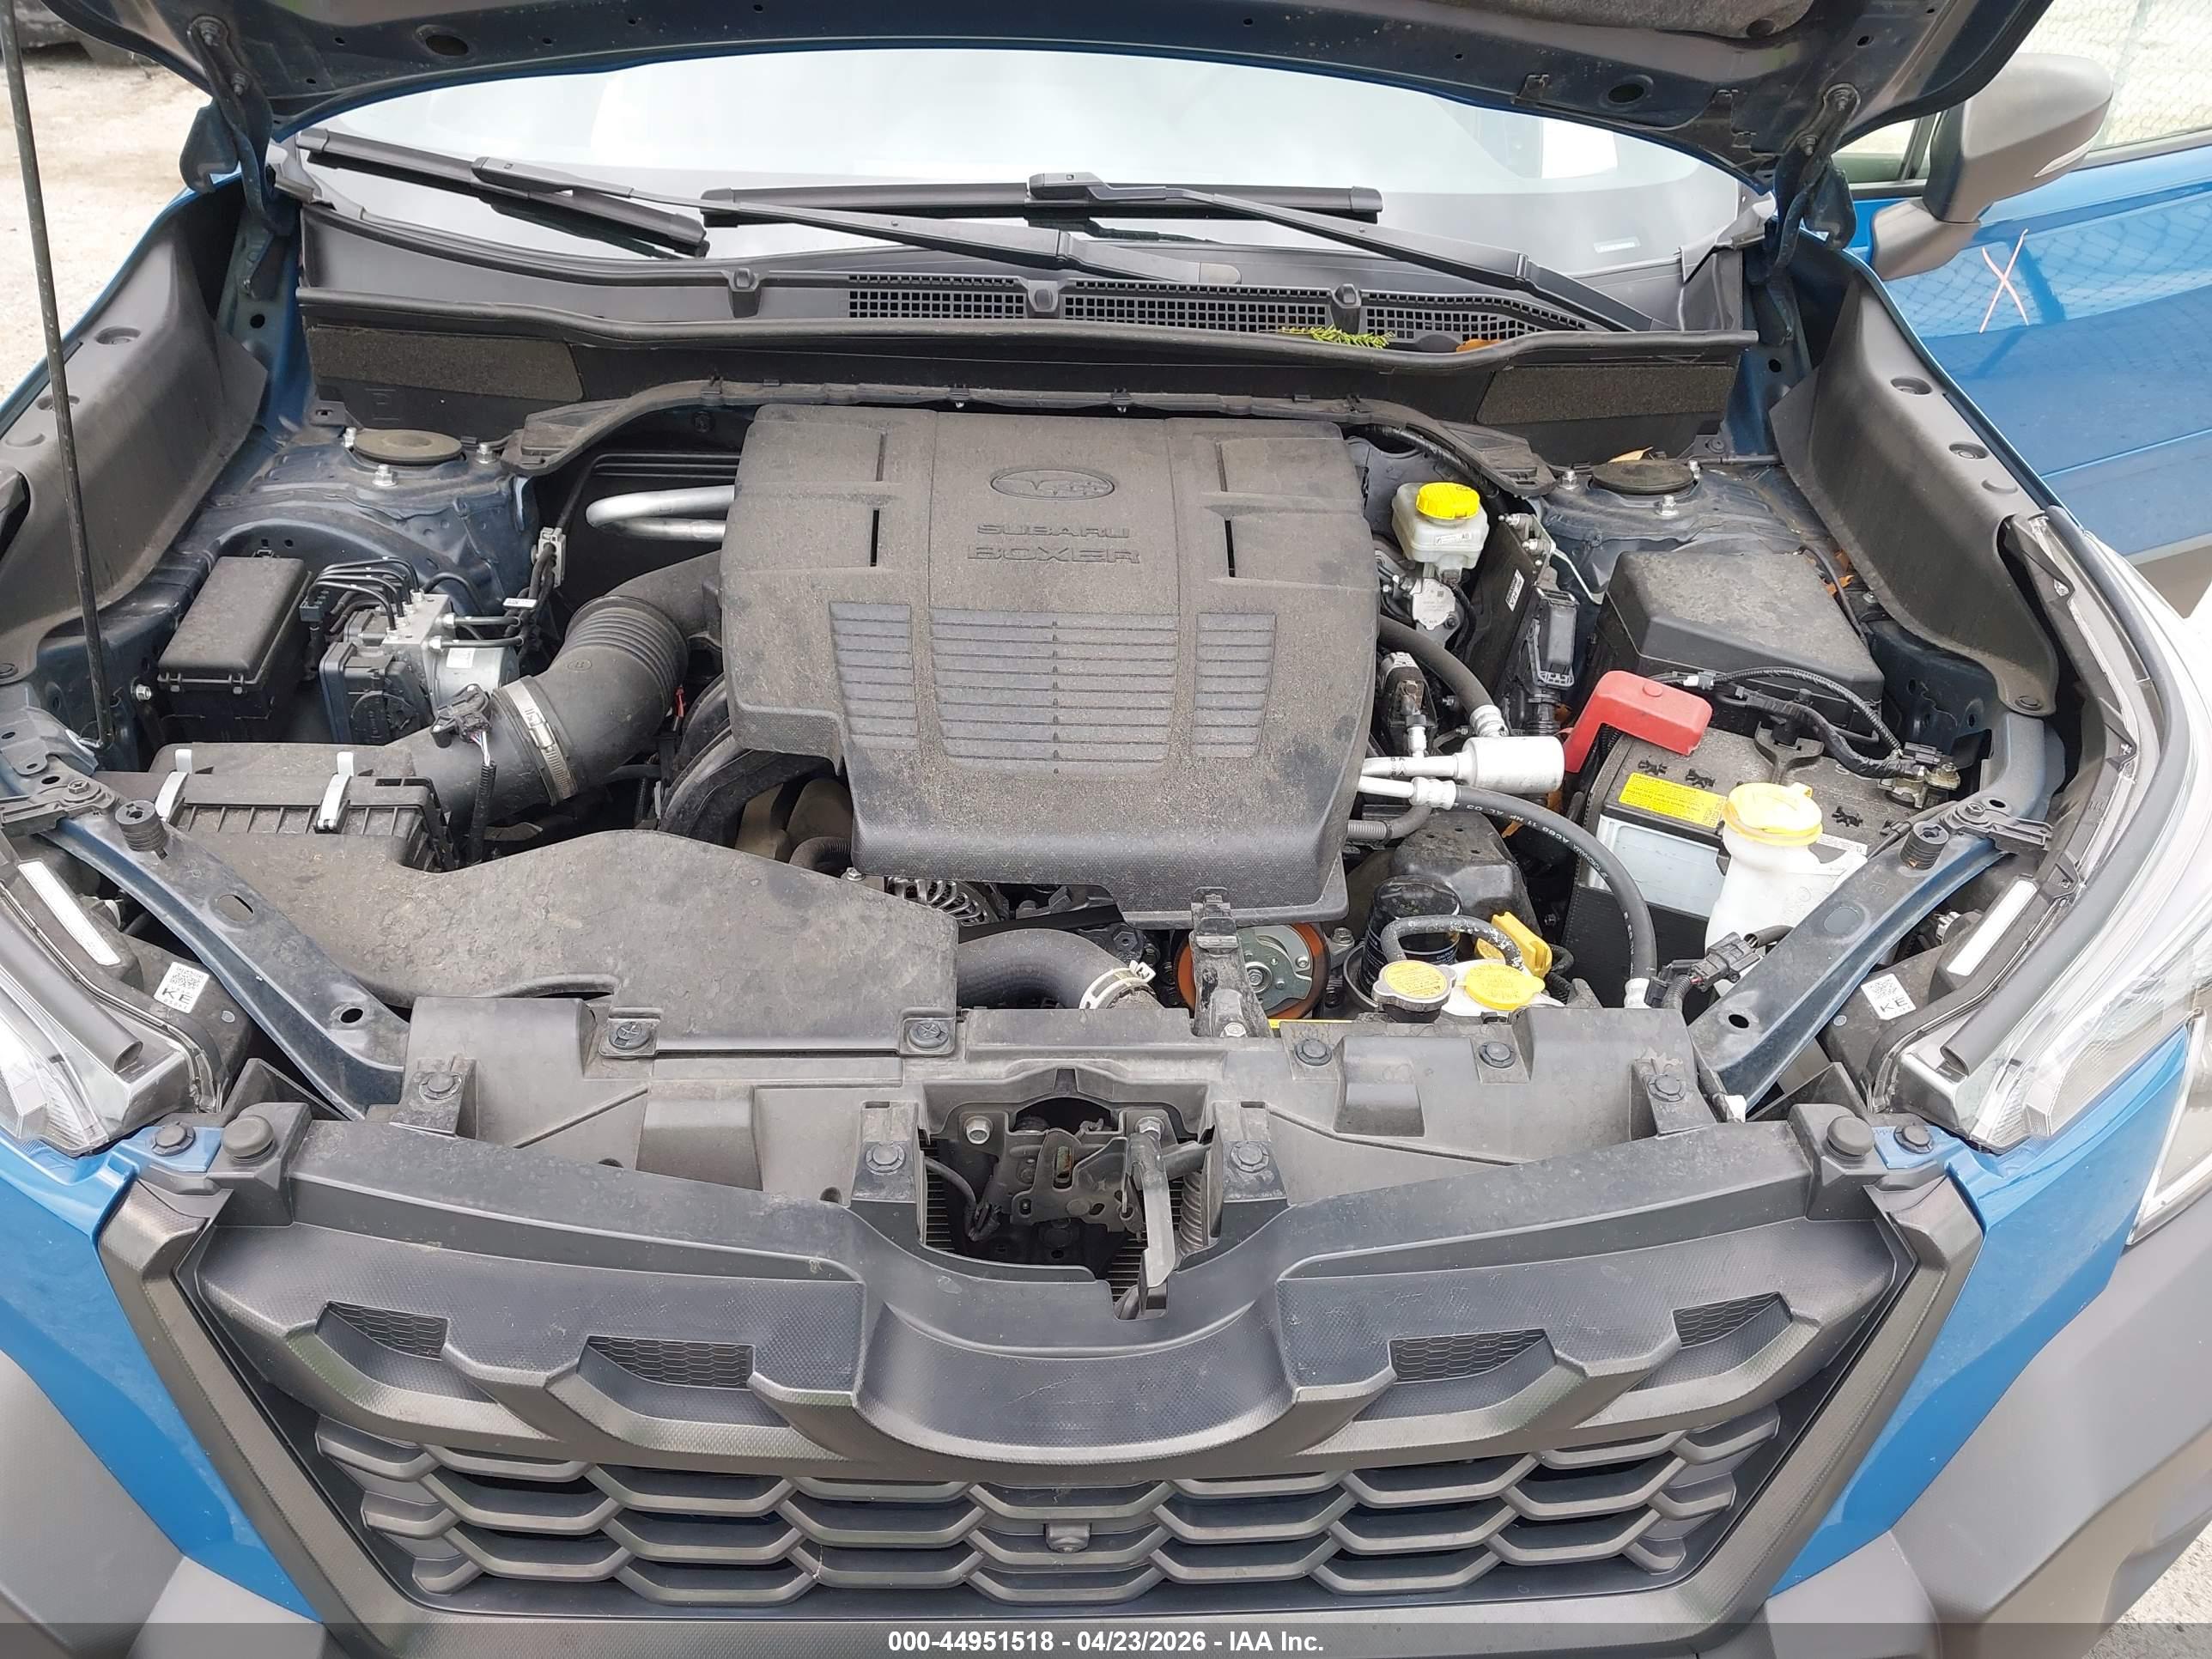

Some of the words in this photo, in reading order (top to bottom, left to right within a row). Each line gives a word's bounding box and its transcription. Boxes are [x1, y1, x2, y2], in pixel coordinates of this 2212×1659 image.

[977, 524, 1130, 538] SUBARU
[968, 545, 1139, 563] BOXER
[1572, 843, 1601, 872] YOKOHAMA
